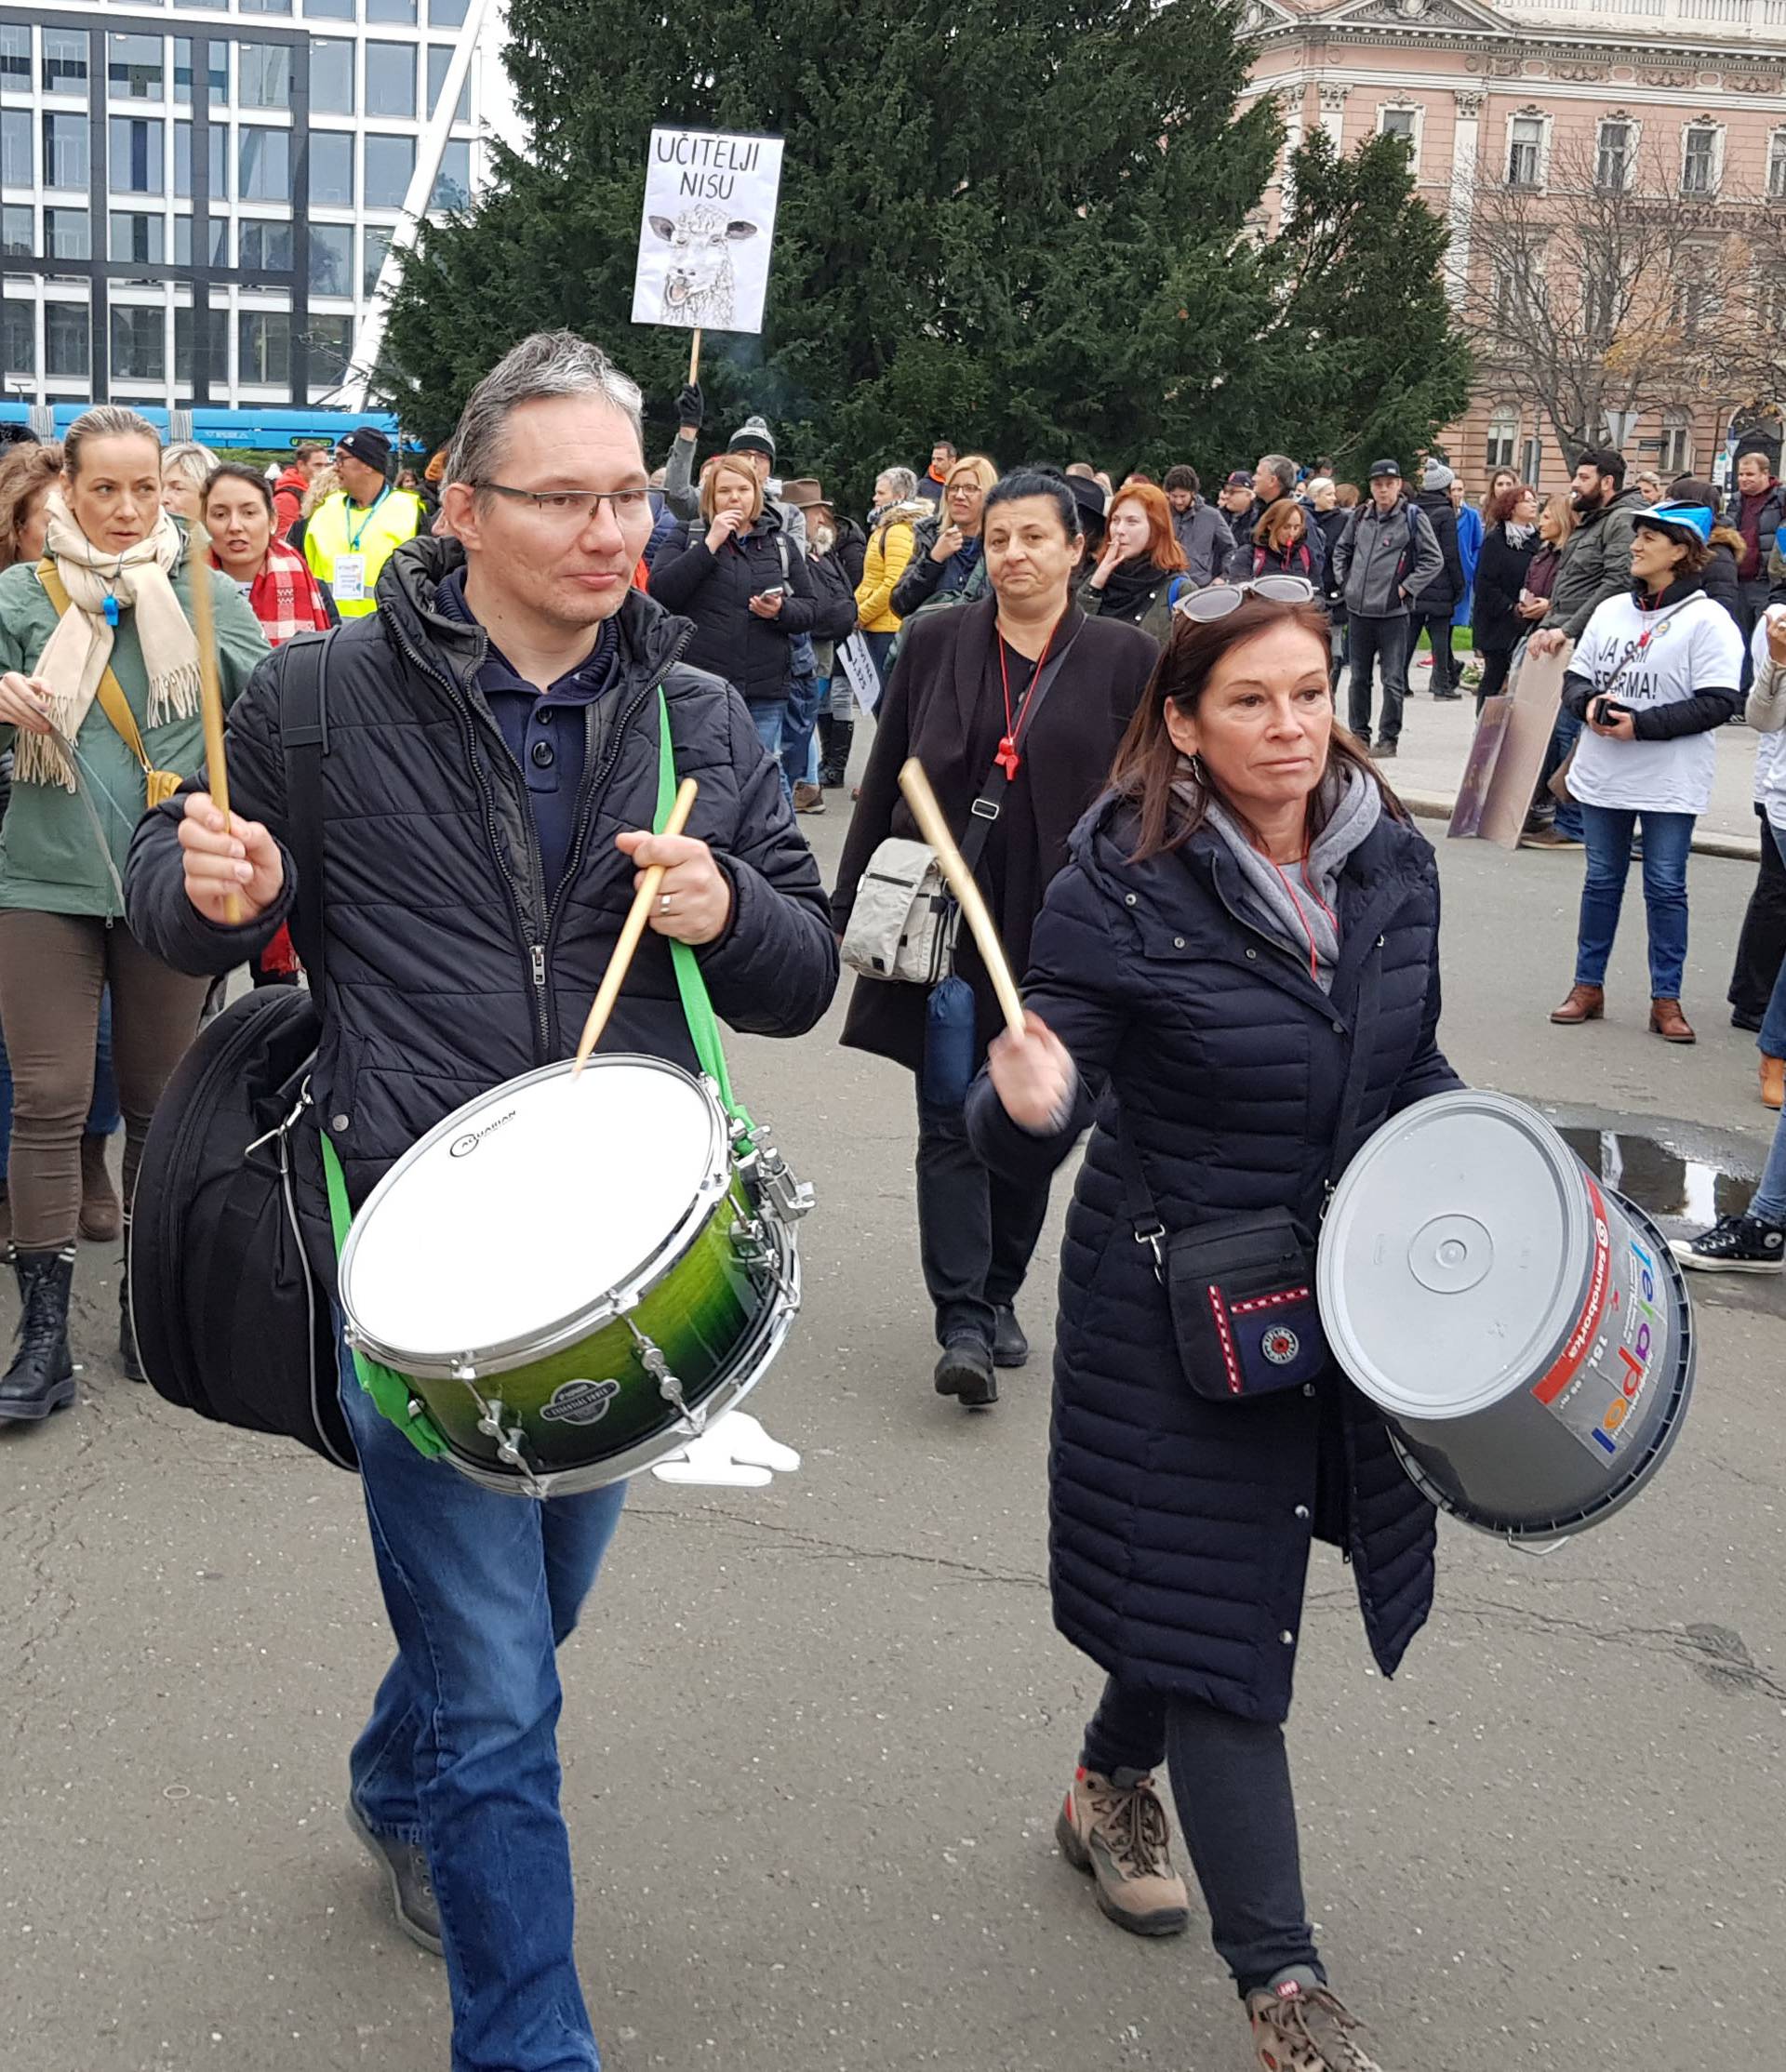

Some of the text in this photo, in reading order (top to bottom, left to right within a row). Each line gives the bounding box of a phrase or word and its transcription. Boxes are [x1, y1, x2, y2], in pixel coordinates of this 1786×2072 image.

[657, 133, 760, 172] UČITELJI
[679, 171, 735, 200] NISU
[1598, 636, 1619, 664] JA
